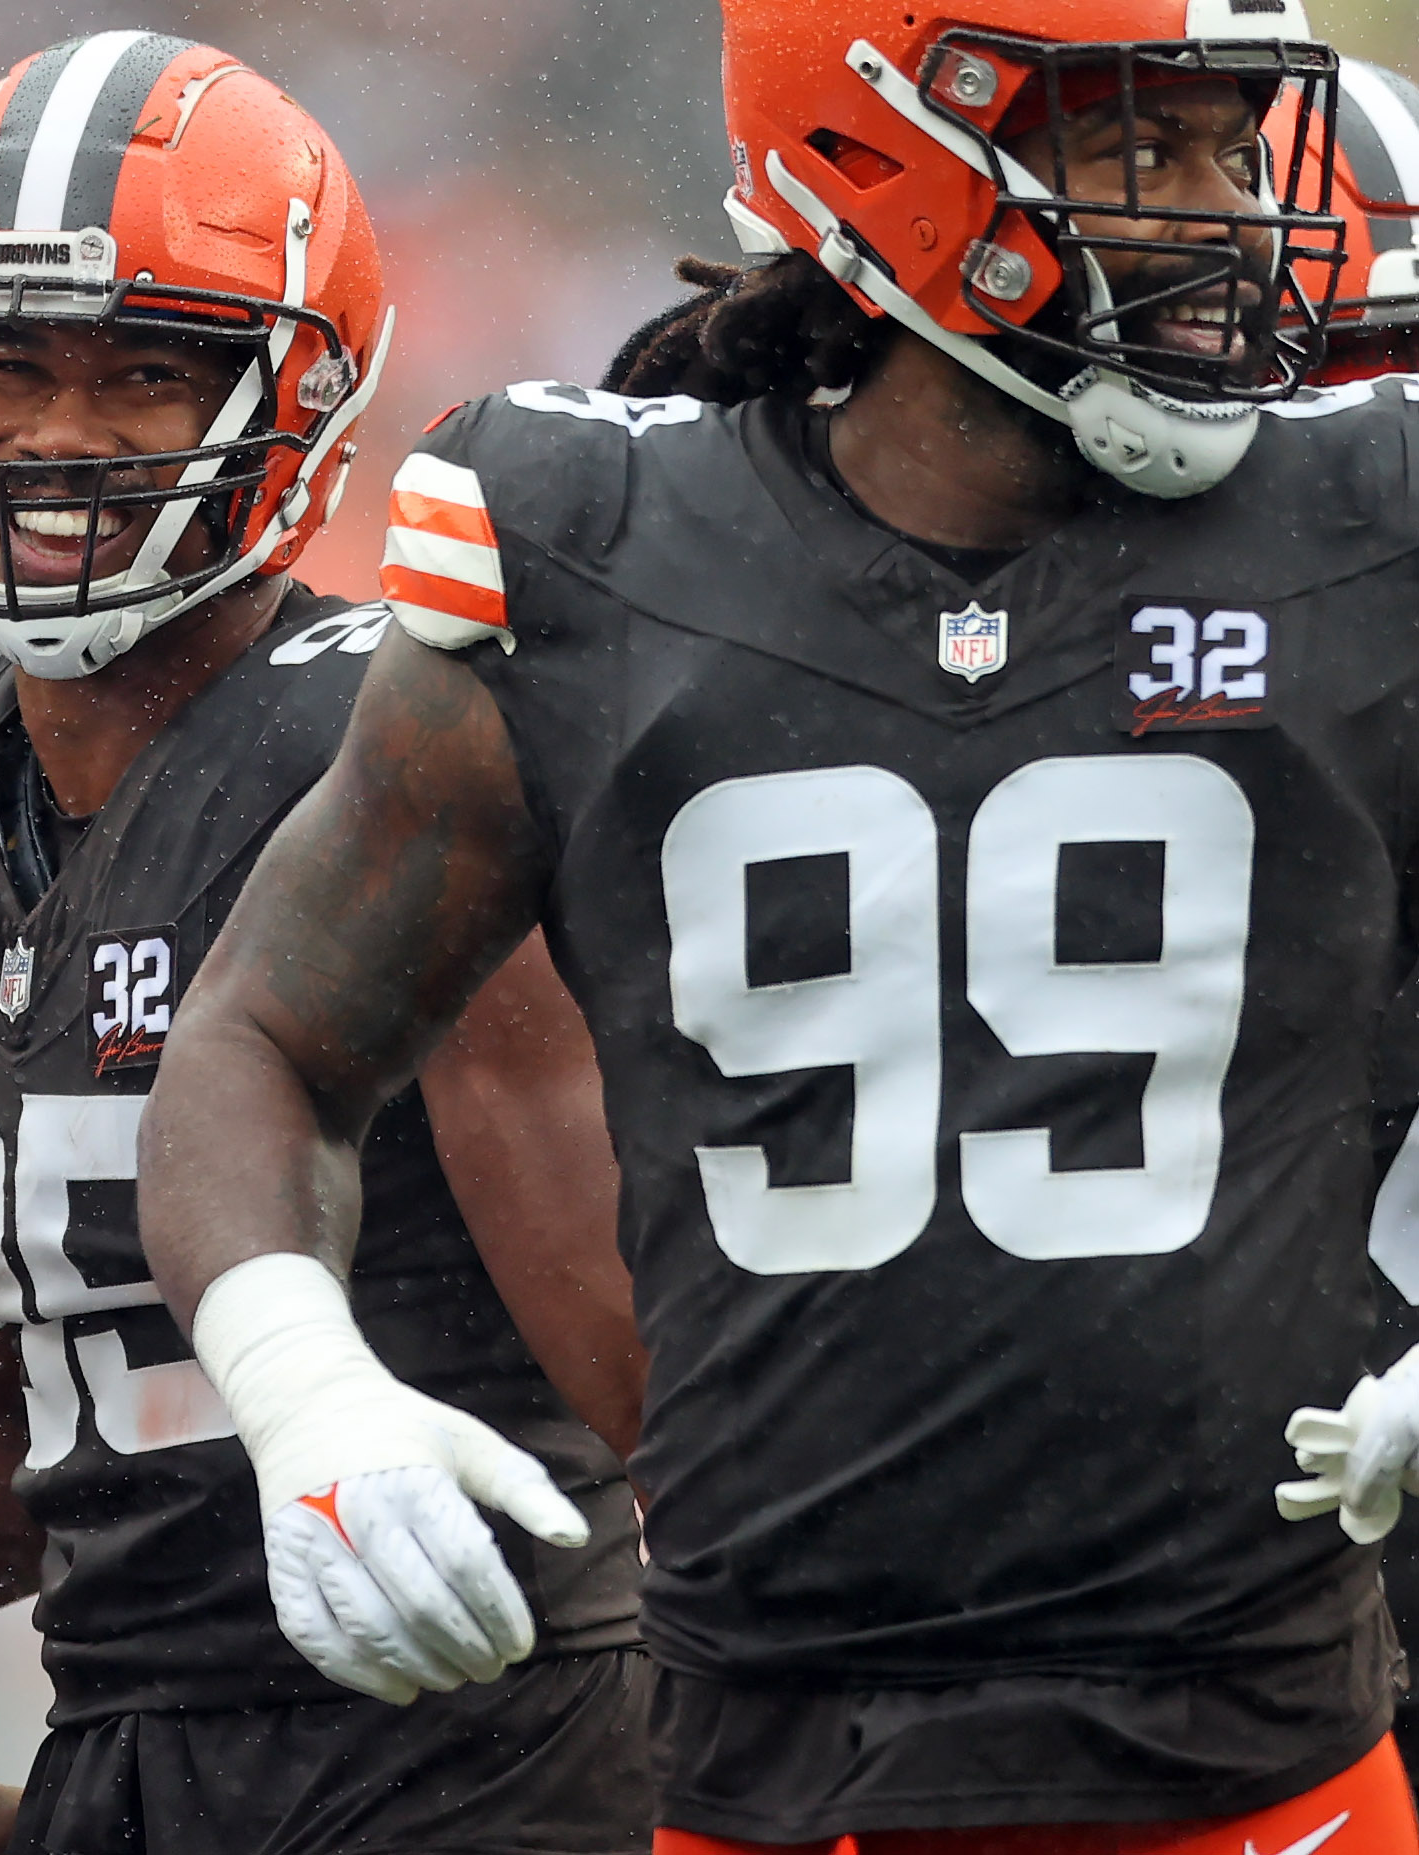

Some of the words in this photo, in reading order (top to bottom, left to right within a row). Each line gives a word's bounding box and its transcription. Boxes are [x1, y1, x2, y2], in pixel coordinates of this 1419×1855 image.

[951, 638, 994, 667] NFL
[1129, 606, 1268, 702] 32
[3, 977, 24, 1006] NFL
[93, 937, 171, 1039] 32
[661, 753, 1255, 1276] 99
